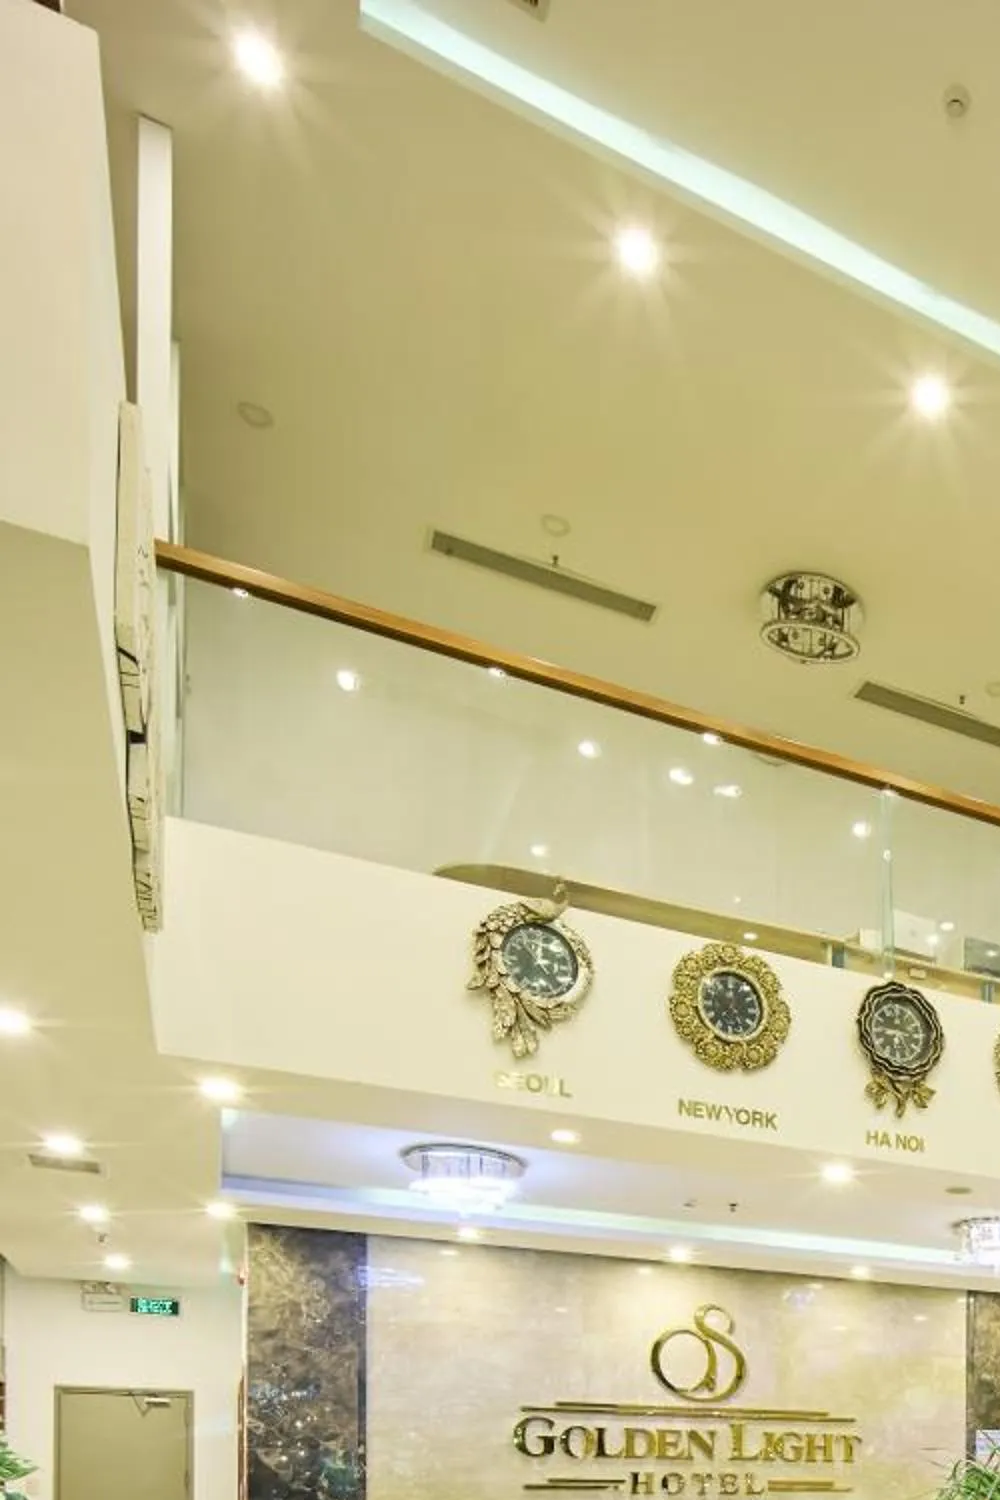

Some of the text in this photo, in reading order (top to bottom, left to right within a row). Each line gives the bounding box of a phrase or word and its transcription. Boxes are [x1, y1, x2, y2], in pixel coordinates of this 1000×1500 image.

[512, 1416, 863, 1463] GOLDEN LIGHT
[629, 1471, 765, 1496] HOTEL
